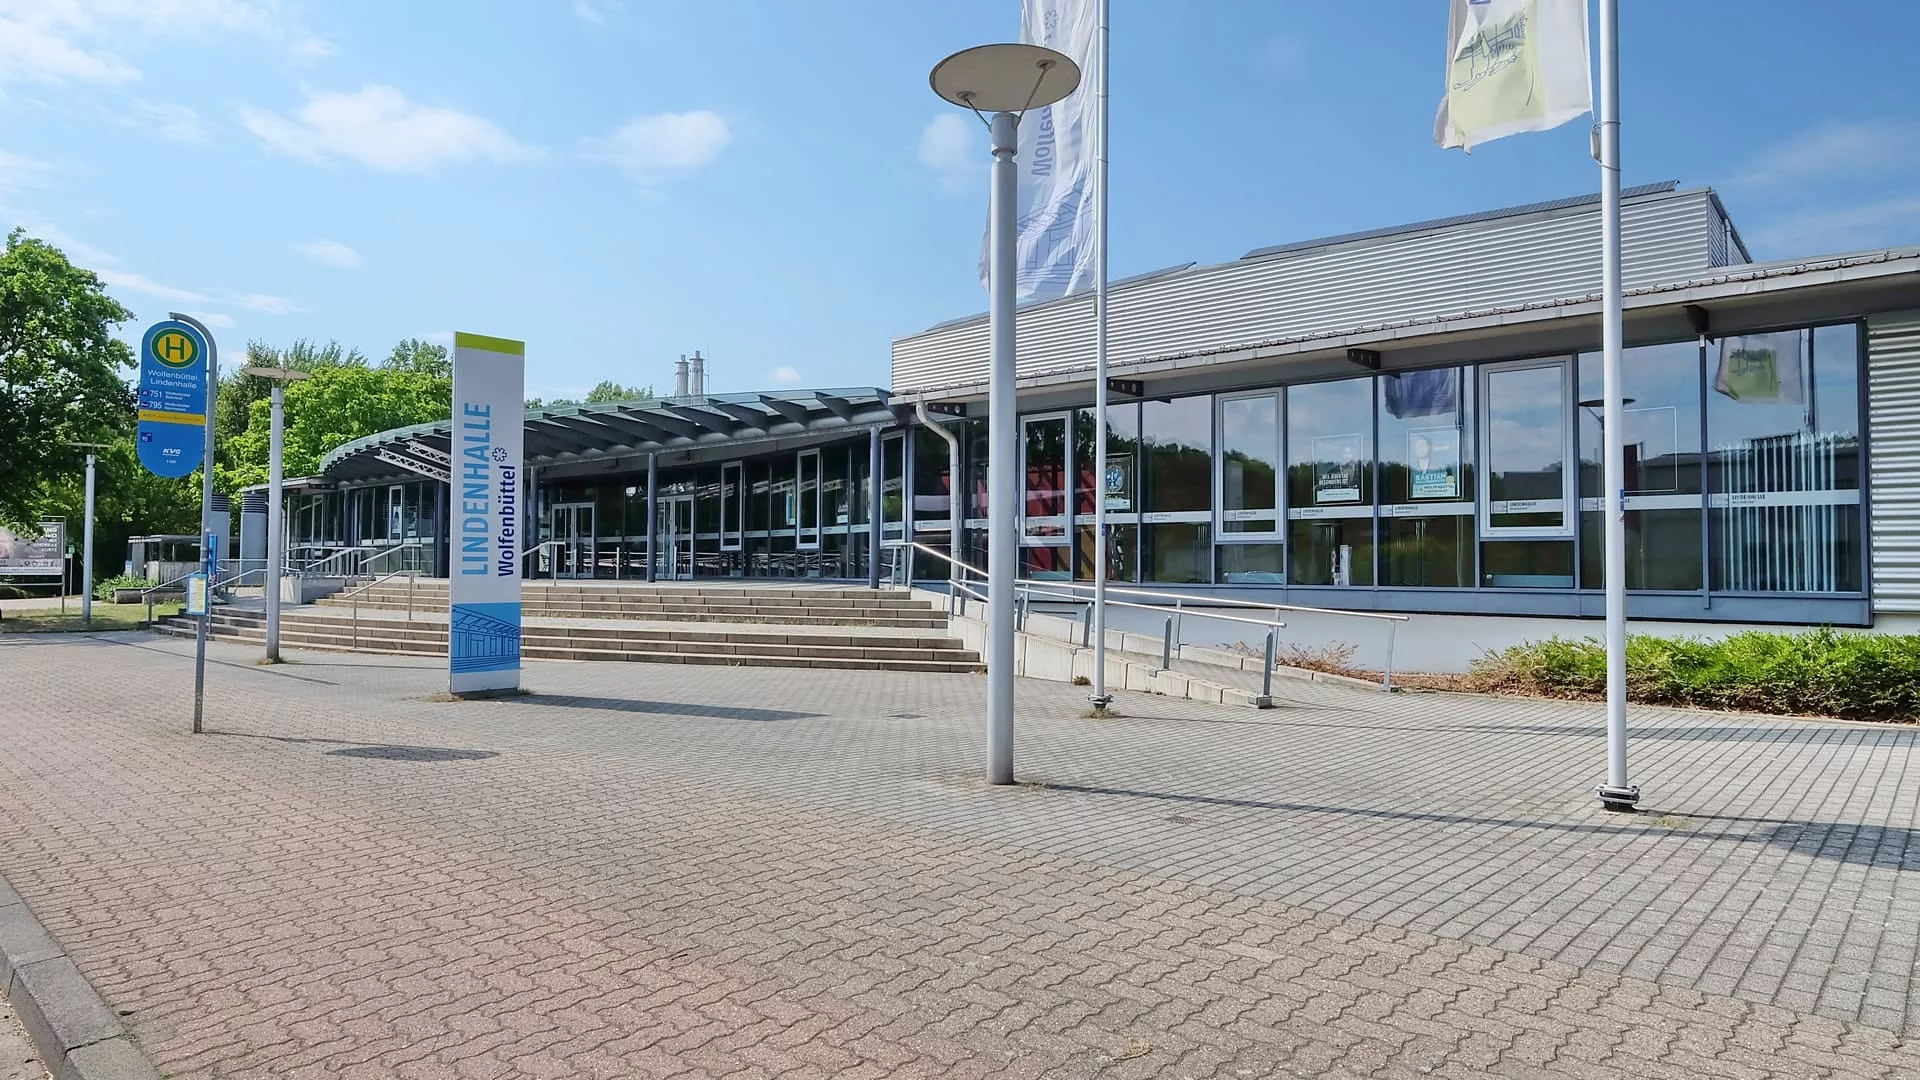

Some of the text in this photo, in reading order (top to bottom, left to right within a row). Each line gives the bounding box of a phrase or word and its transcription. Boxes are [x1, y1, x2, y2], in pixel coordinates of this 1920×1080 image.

[165, 336, 185, 360] H
[150, 378, 197, 389] Lindenhalle
[149, 390, 162, 398] 751
[149, 400, 162, 409] 795
[462, 403, 491, 576] LINDENHALLE
[498, 465, 516, 577] Wolfenbüttel
